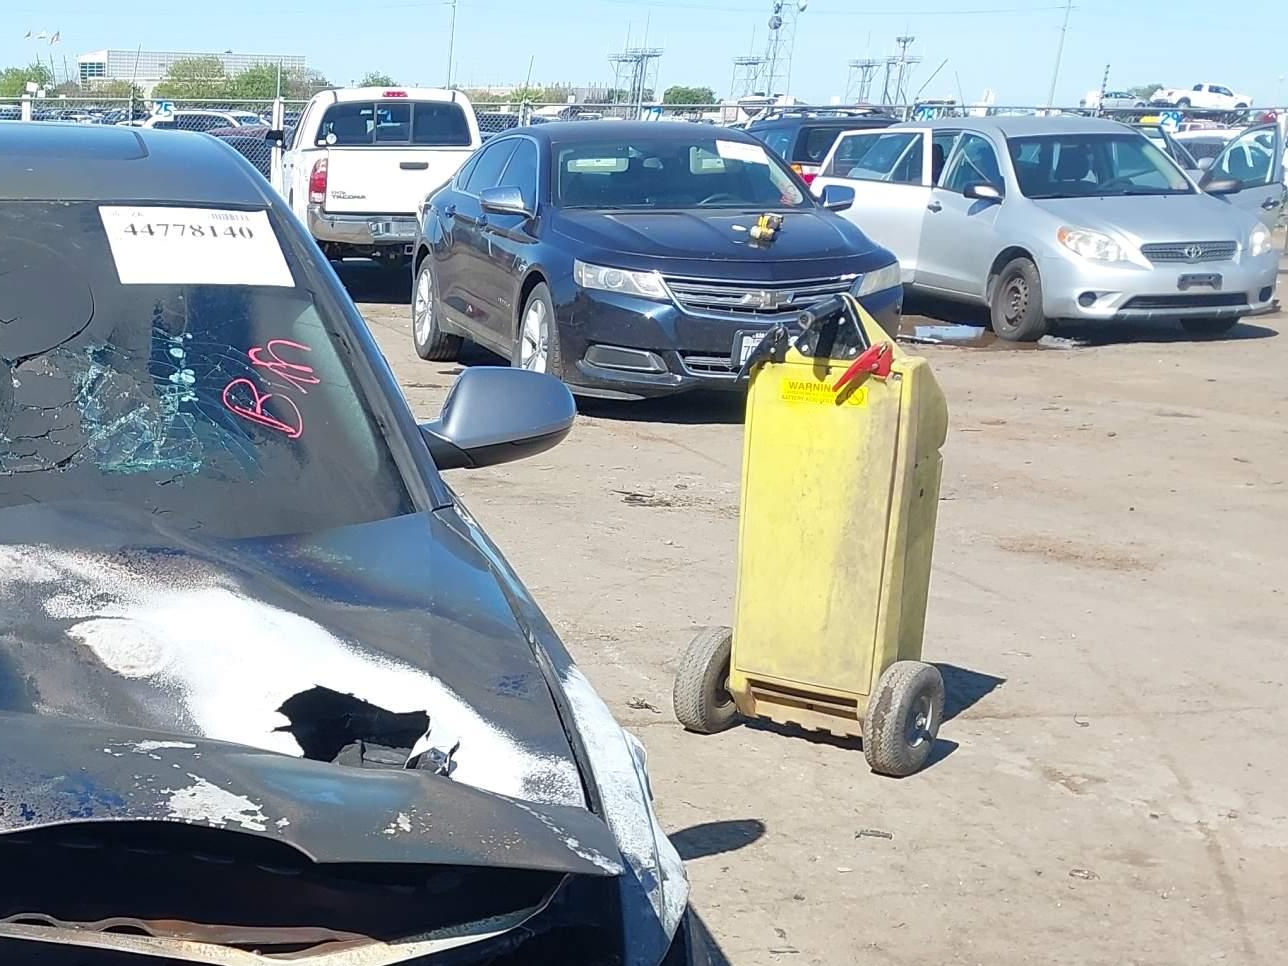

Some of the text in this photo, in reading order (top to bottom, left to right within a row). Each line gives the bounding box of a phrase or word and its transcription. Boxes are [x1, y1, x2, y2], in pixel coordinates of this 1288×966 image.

[155, 101, 173, 117] 25
[1161, 111, 1183, 128] 29
[124, 223, 254, 239] 44778140
[788, 381, 832, 392] WARNIN
